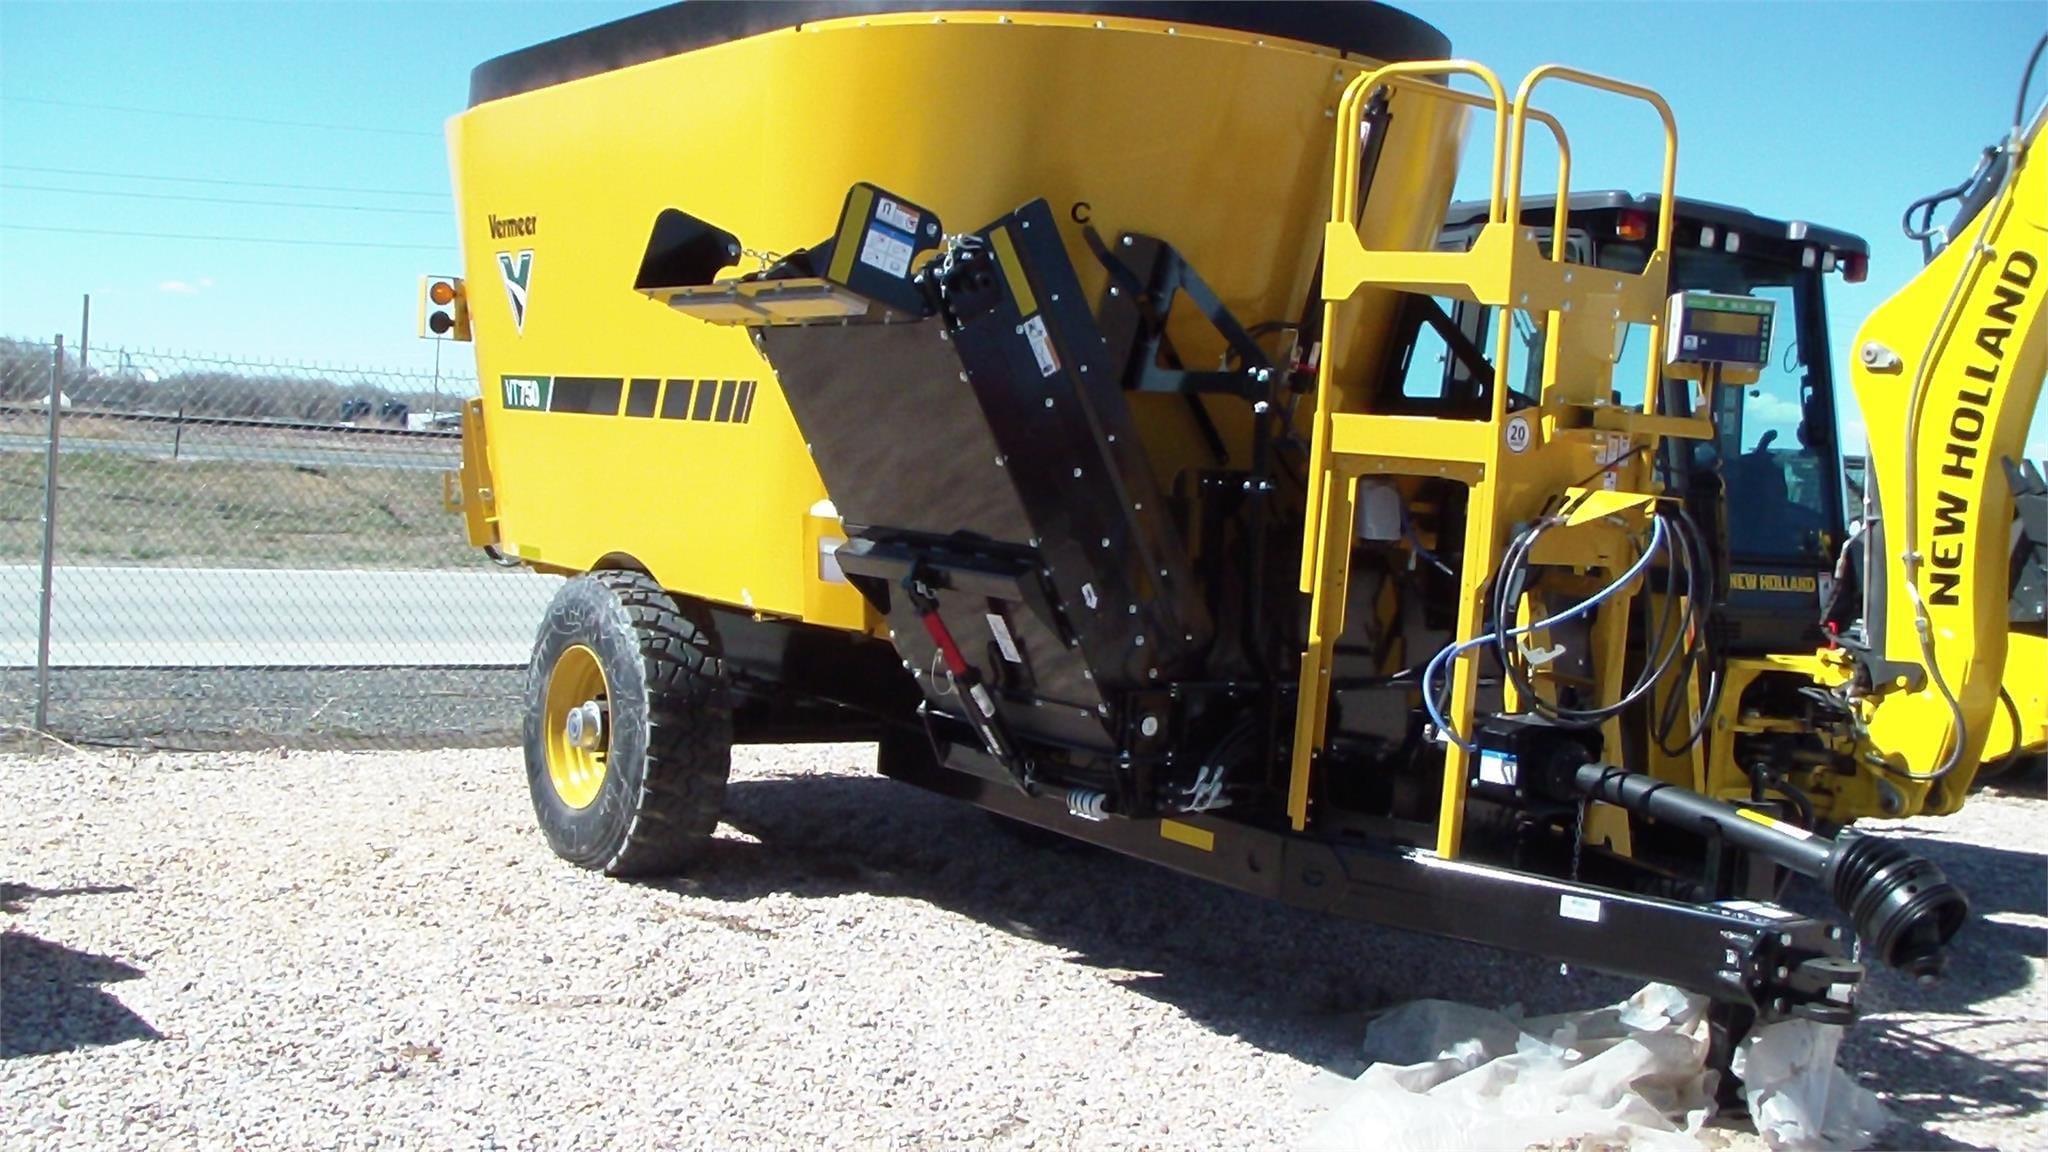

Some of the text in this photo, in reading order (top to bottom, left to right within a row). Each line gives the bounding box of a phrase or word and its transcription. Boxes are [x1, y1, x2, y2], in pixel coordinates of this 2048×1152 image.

[488, 214, 537, 239] Vermeer
[504, 379, 541, 407] VT750
[1510, 425, 1526, 441] 20
[1929, 250, 2039, 606] NEW HOLLAND
[1729, 573, 1816, 592] NEW HOLLAND
